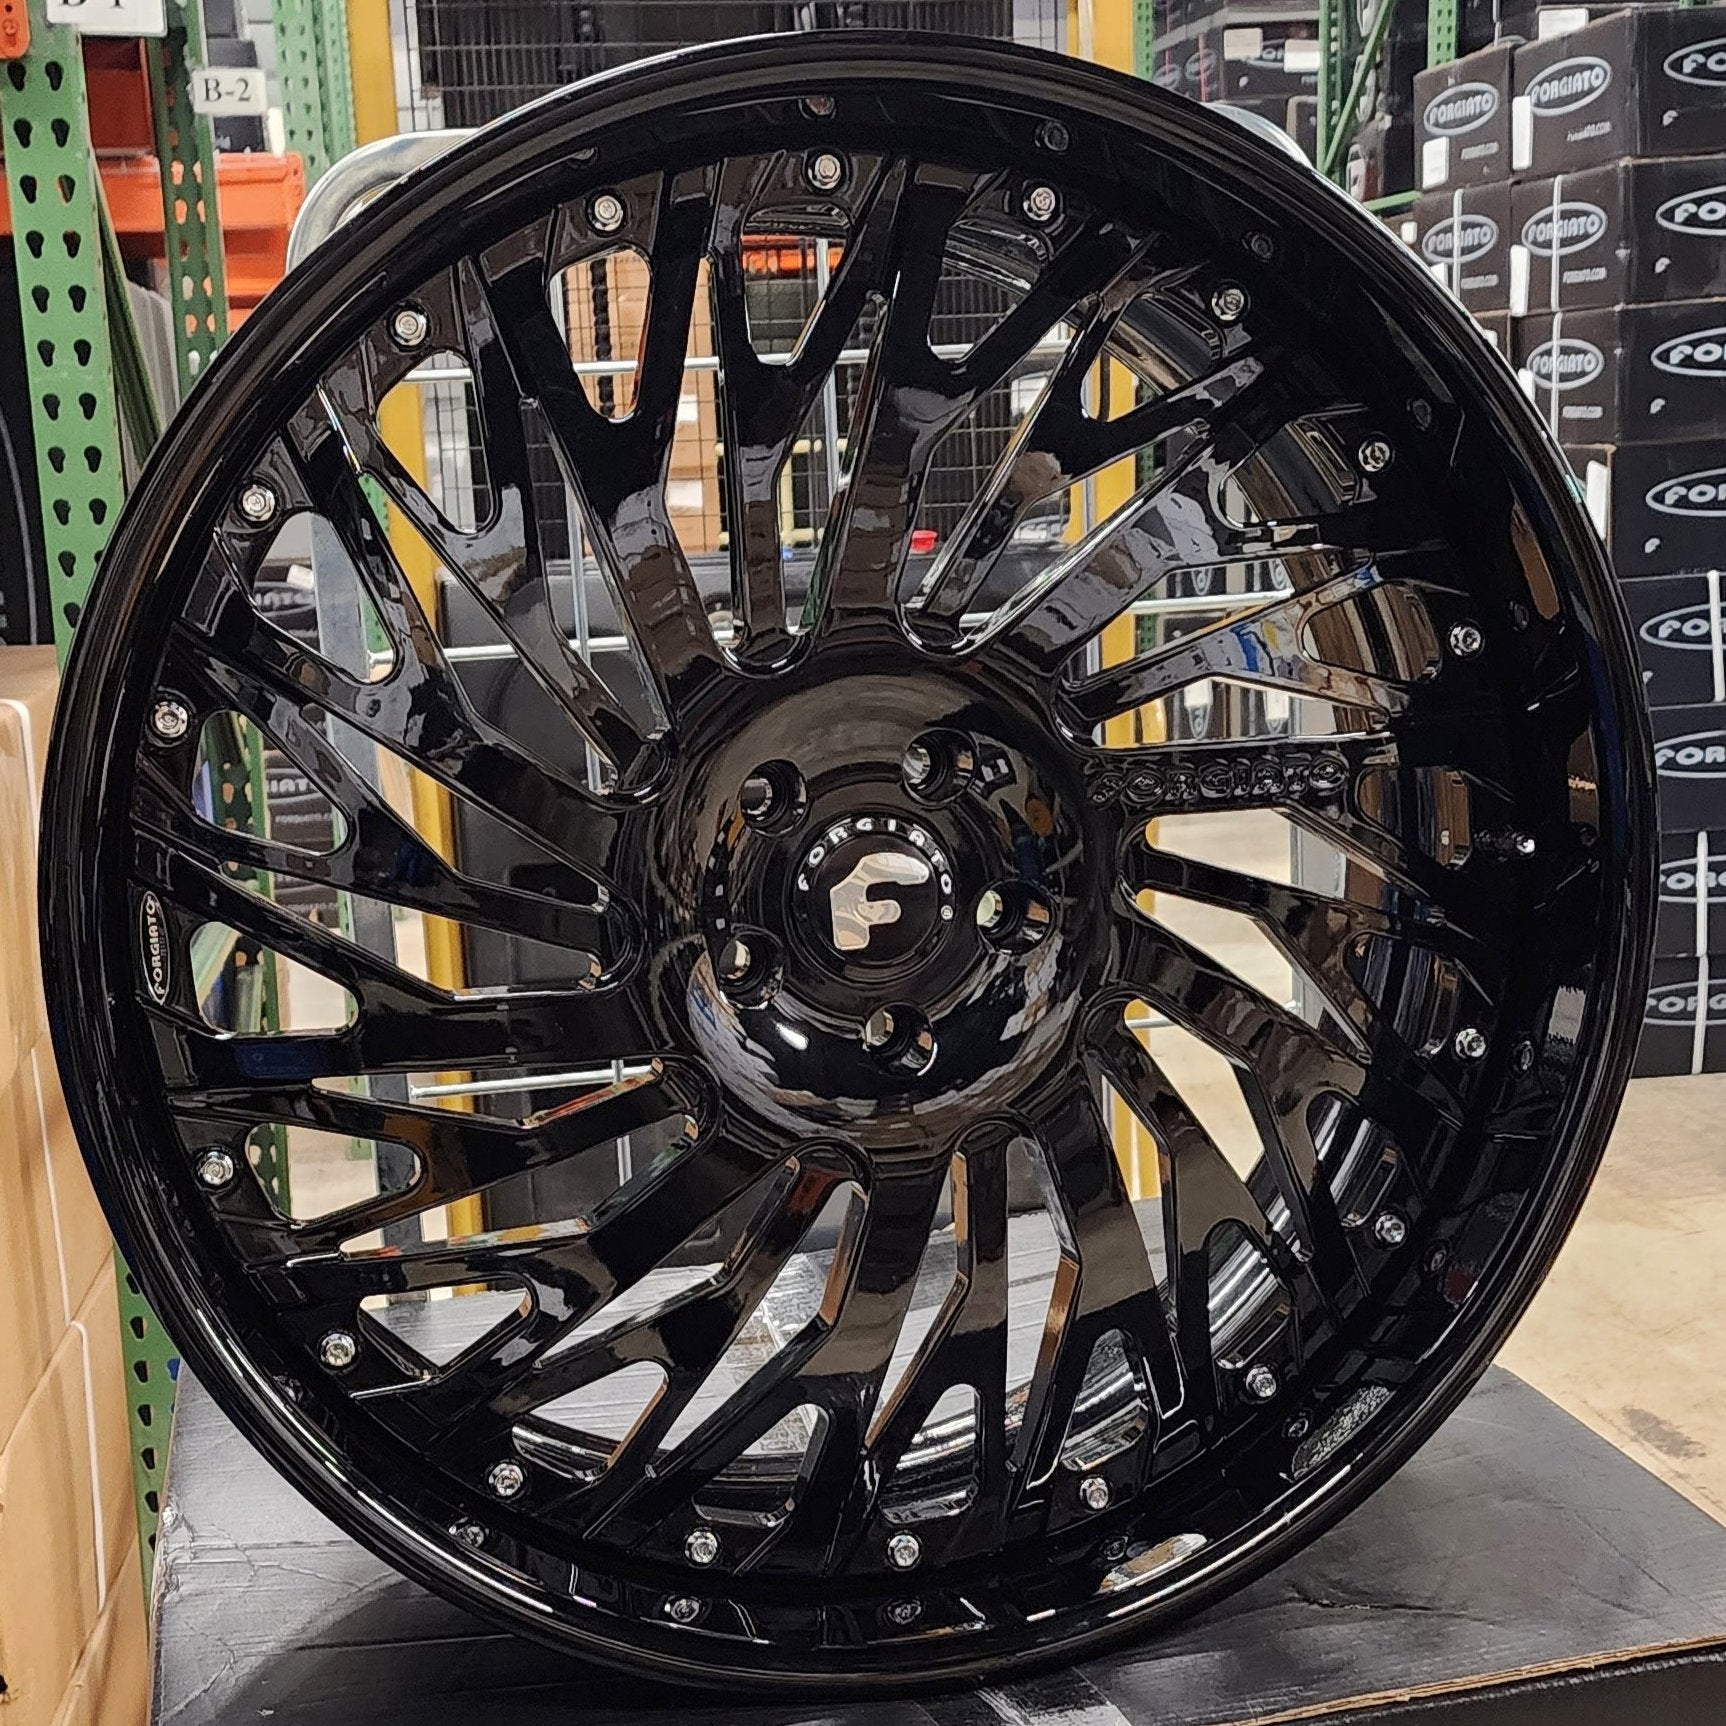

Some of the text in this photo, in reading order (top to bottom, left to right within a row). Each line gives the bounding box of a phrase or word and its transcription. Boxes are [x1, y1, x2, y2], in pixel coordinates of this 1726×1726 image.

[204, 78, 252, 102] B-2
[1531, 66, 1605, 106] FORGIATO
[1429, 92, 1493, 126] FORGIATO
[1428, 225, 1492, 253] FORIATO
[1670, 343, 1726, 365] FO
[797, 817, 952, 895] FORGIATO
[145, 895, 166, 995] FORGIATO
